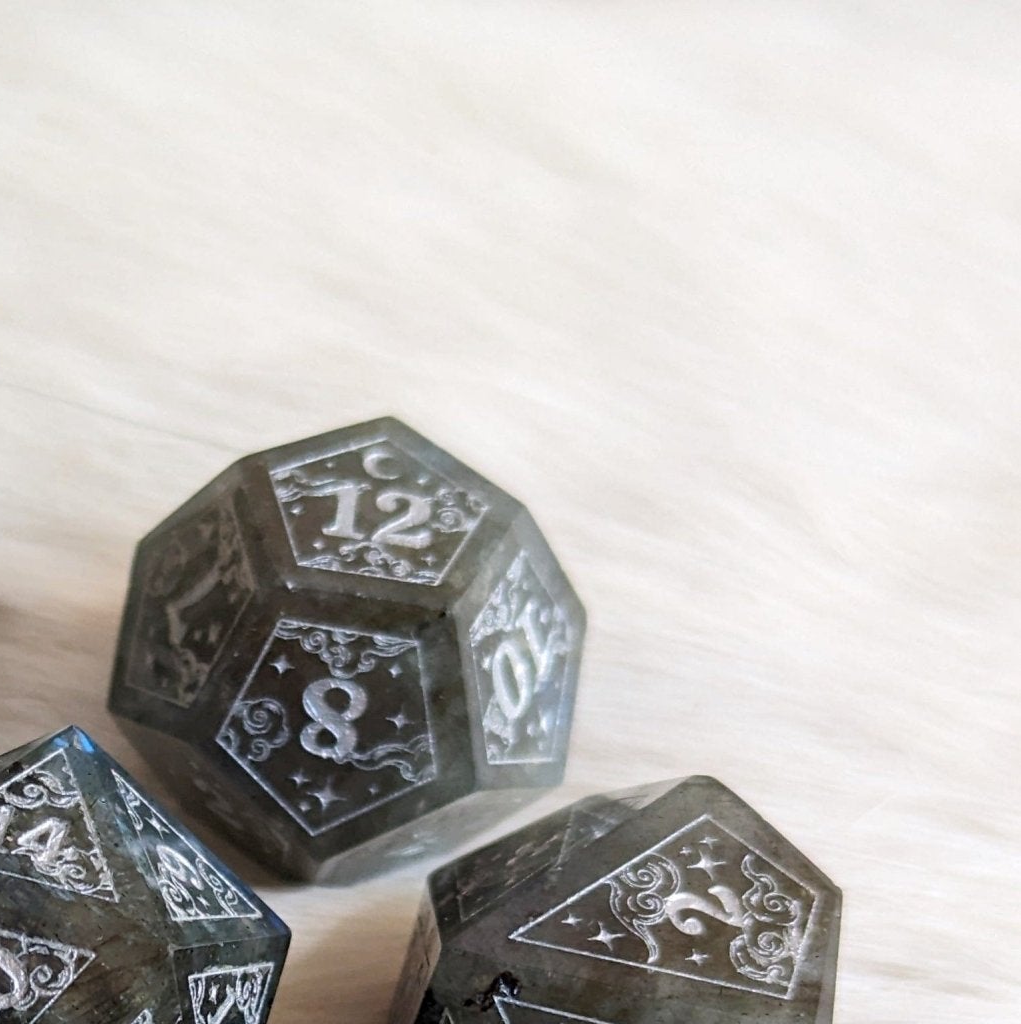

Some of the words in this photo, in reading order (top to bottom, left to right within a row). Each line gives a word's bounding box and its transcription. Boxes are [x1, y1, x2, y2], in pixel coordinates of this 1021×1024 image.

[322, 483, 432, 548] 12
[300, 677, 368, 760] 8
[665, 886, 746, 934] 2
